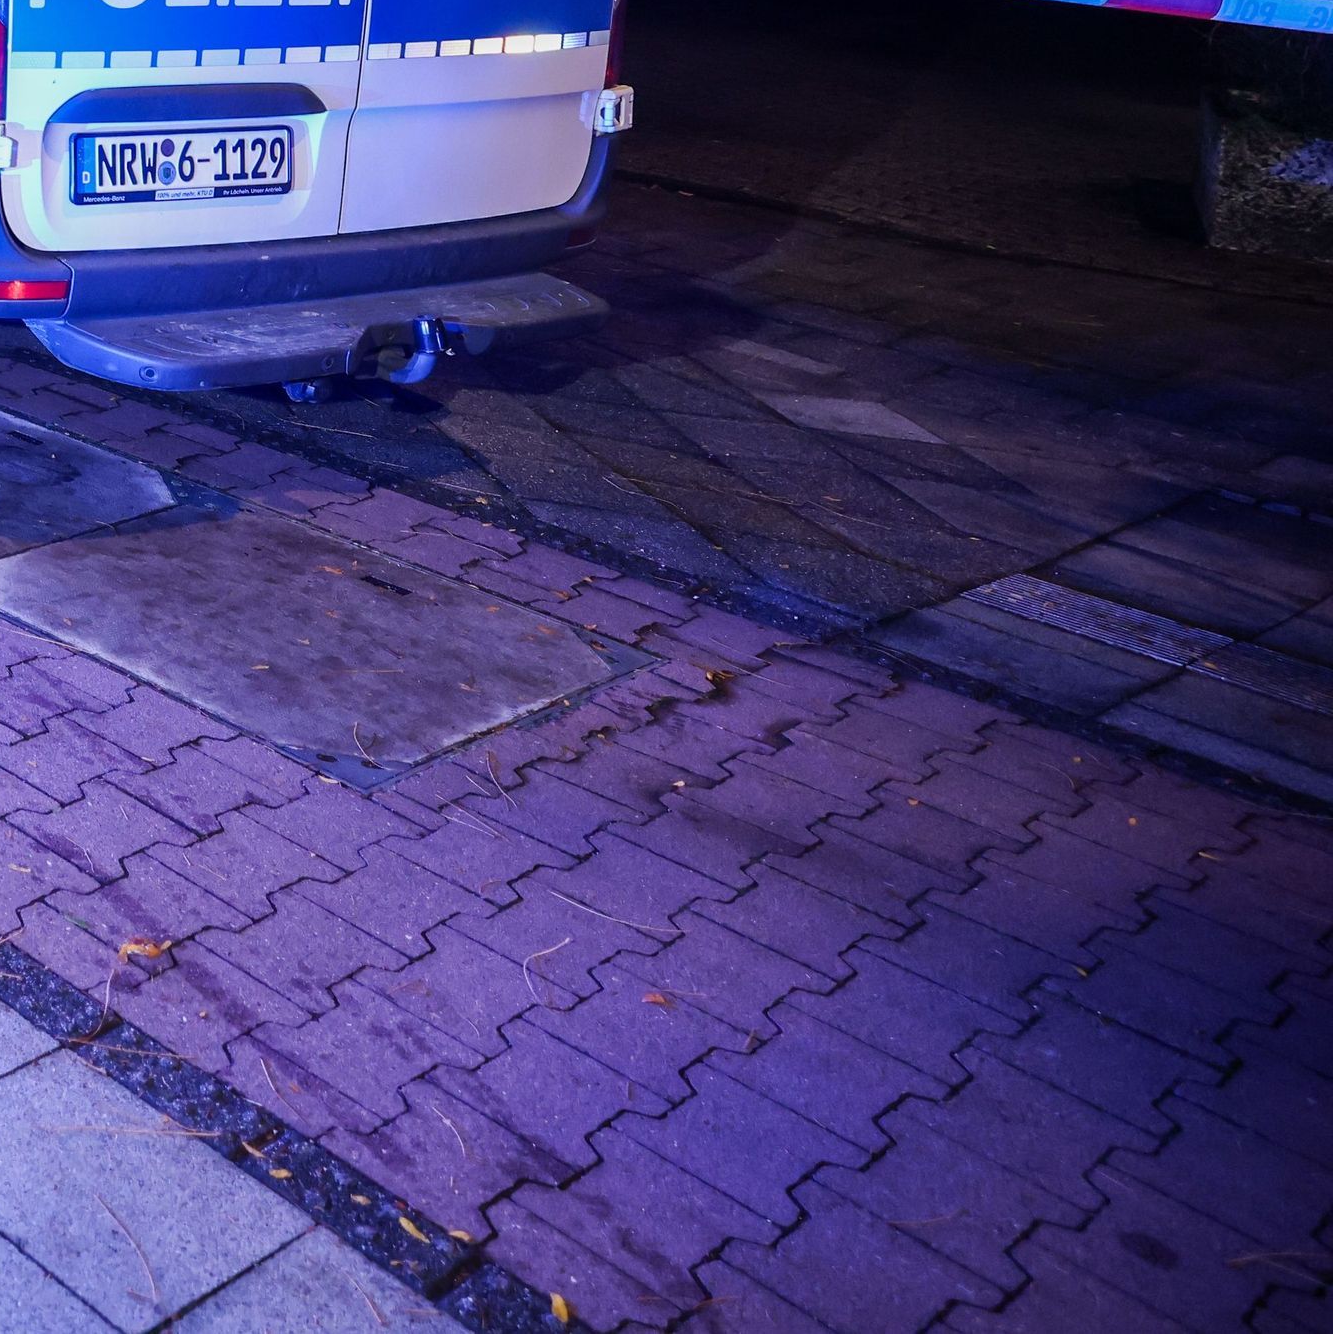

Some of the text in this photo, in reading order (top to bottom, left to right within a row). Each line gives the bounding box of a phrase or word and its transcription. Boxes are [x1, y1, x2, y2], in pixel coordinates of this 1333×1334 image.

[98, 137, 286, 187] NRW 6-1129
[82, 171, 91, 184] D
[83, 195, 126, 203] Mercedes-Benz
